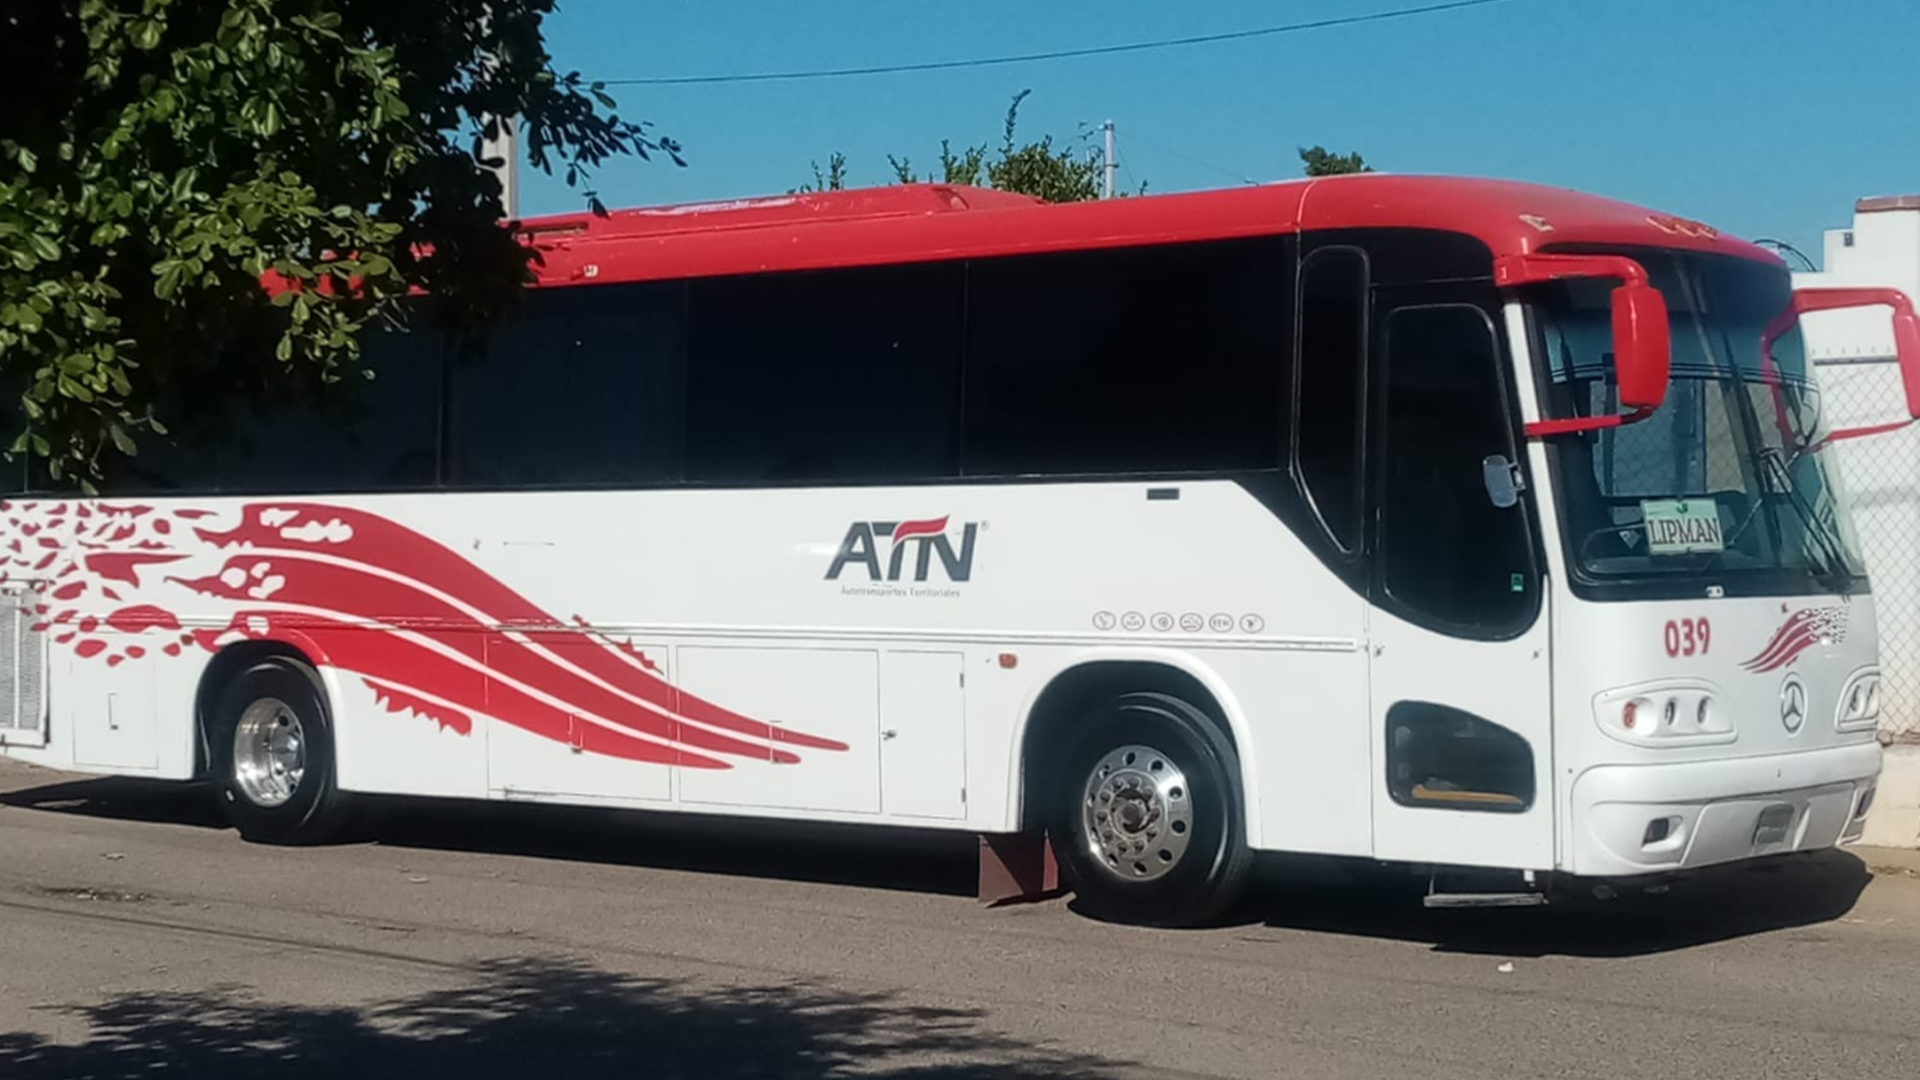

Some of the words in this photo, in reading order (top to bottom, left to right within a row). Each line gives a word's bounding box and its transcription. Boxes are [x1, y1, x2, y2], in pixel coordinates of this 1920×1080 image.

[1648, 517, 1720, 545] LIPMAN
[841, 585, 907, 598] Autotransportes
[909, 587, 960, 598] Territoriales
[1665, 616, 1710, 658] 039
